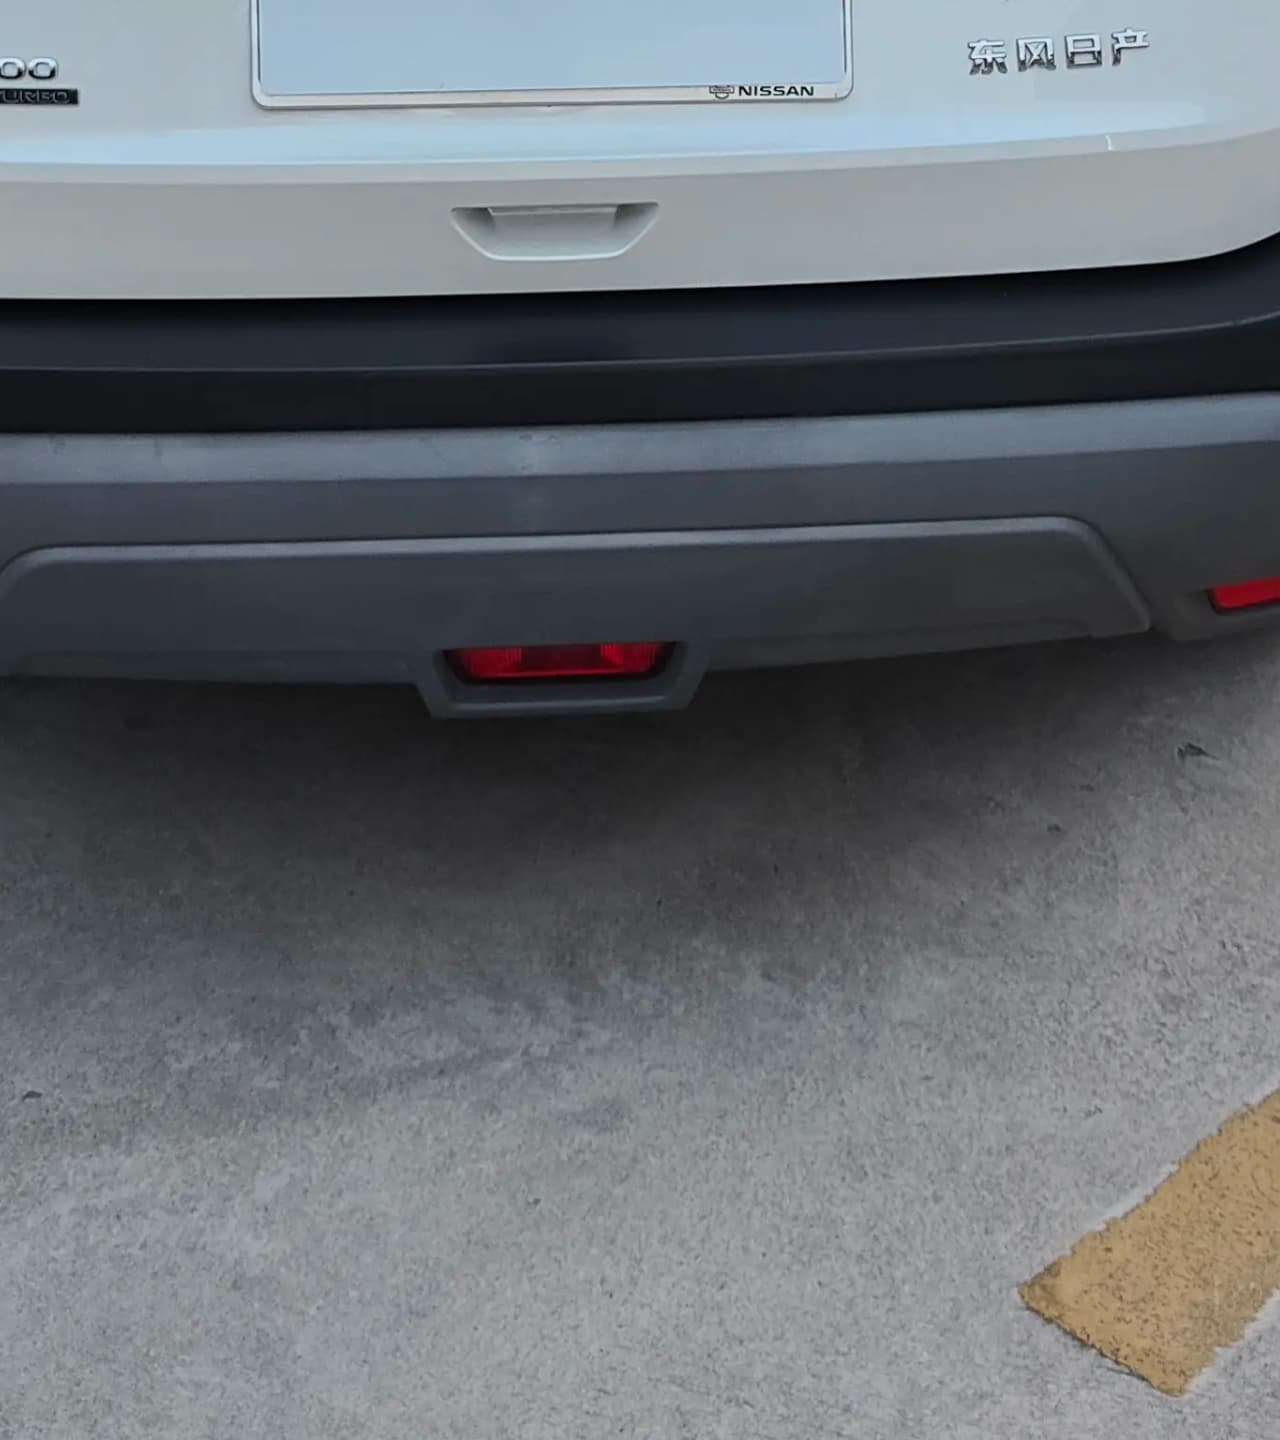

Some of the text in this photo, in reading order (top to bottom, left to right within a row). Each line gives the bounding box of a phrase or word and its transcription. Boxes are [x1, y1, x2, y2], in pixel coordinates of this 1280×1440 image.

[967, 27, 1150, 76] 东风日产
[738, 85, 814, 97] NISSAN
